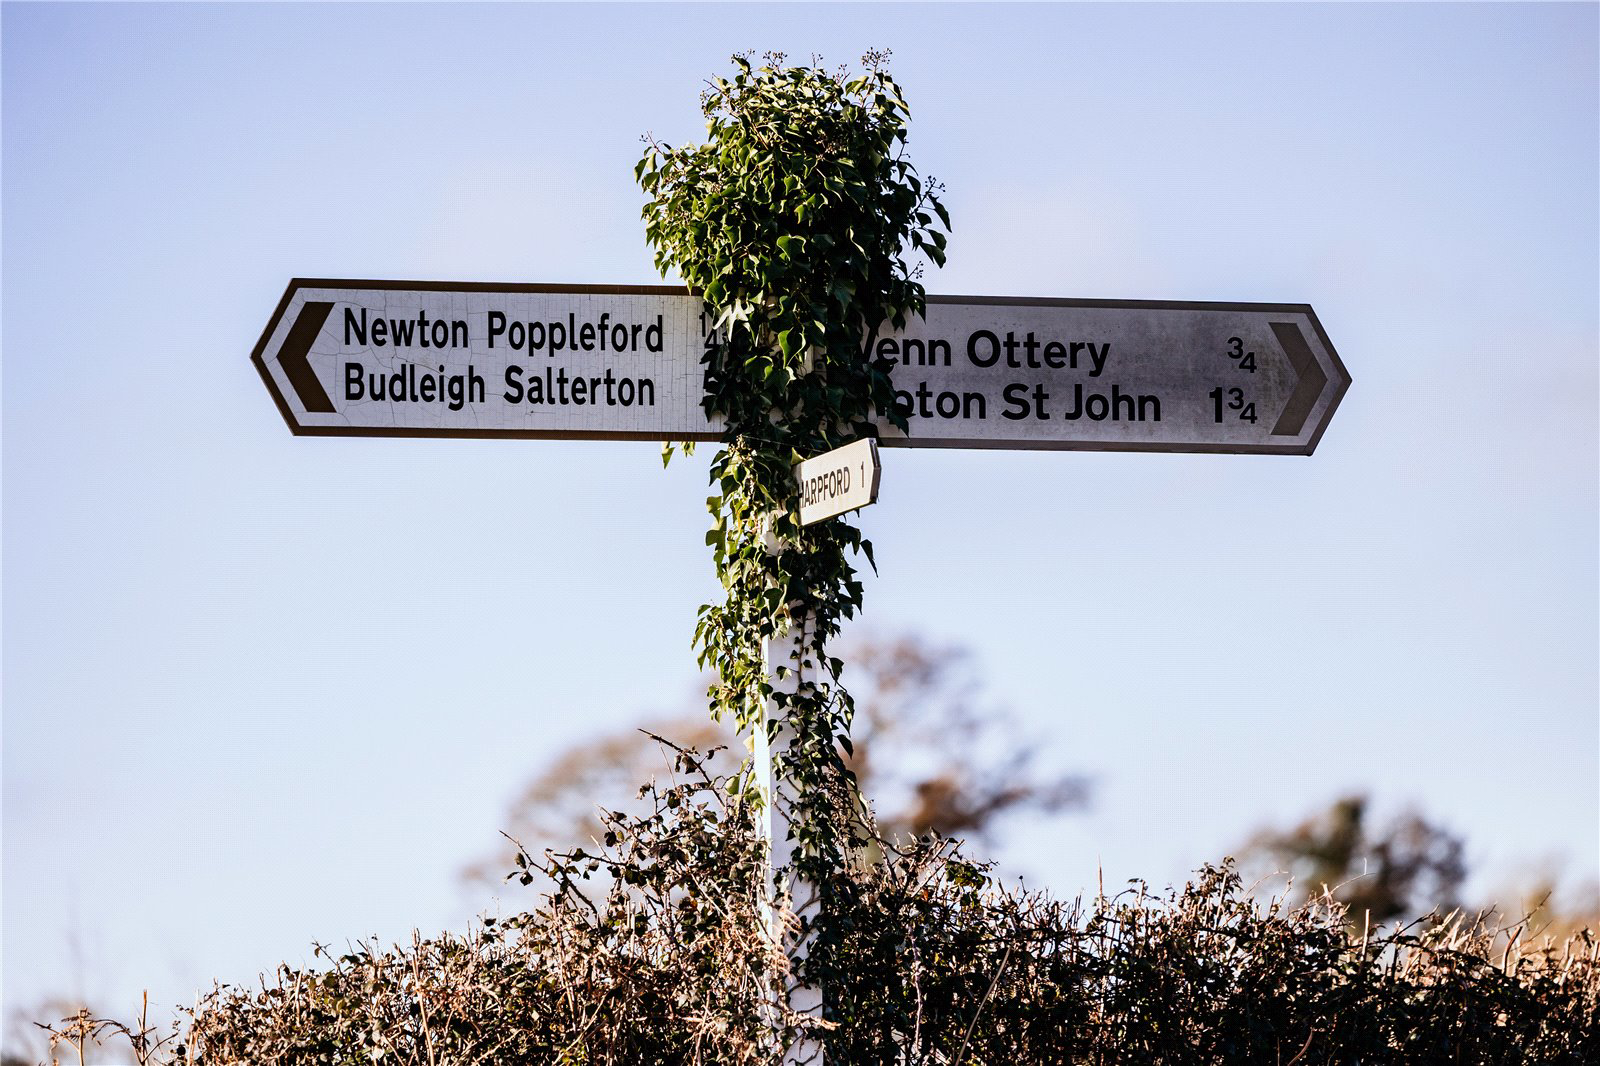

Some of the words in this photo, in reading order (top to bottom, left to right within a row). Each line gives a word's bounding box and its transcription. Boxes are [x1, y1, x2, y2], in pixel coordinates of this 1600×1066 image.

[344, 307, 469, 349] Newton
[487, 310, 664, 358] Poppleford
[966, 329, 1111, 378] Ottery
[344, 362, 485, 412] Budleigh
[503, 364, 655, 407] Salterton
[1000, 382, 1051, 421] St
[1064, 383, 1161, 422] John
[860, 460, 865, 489] 1
